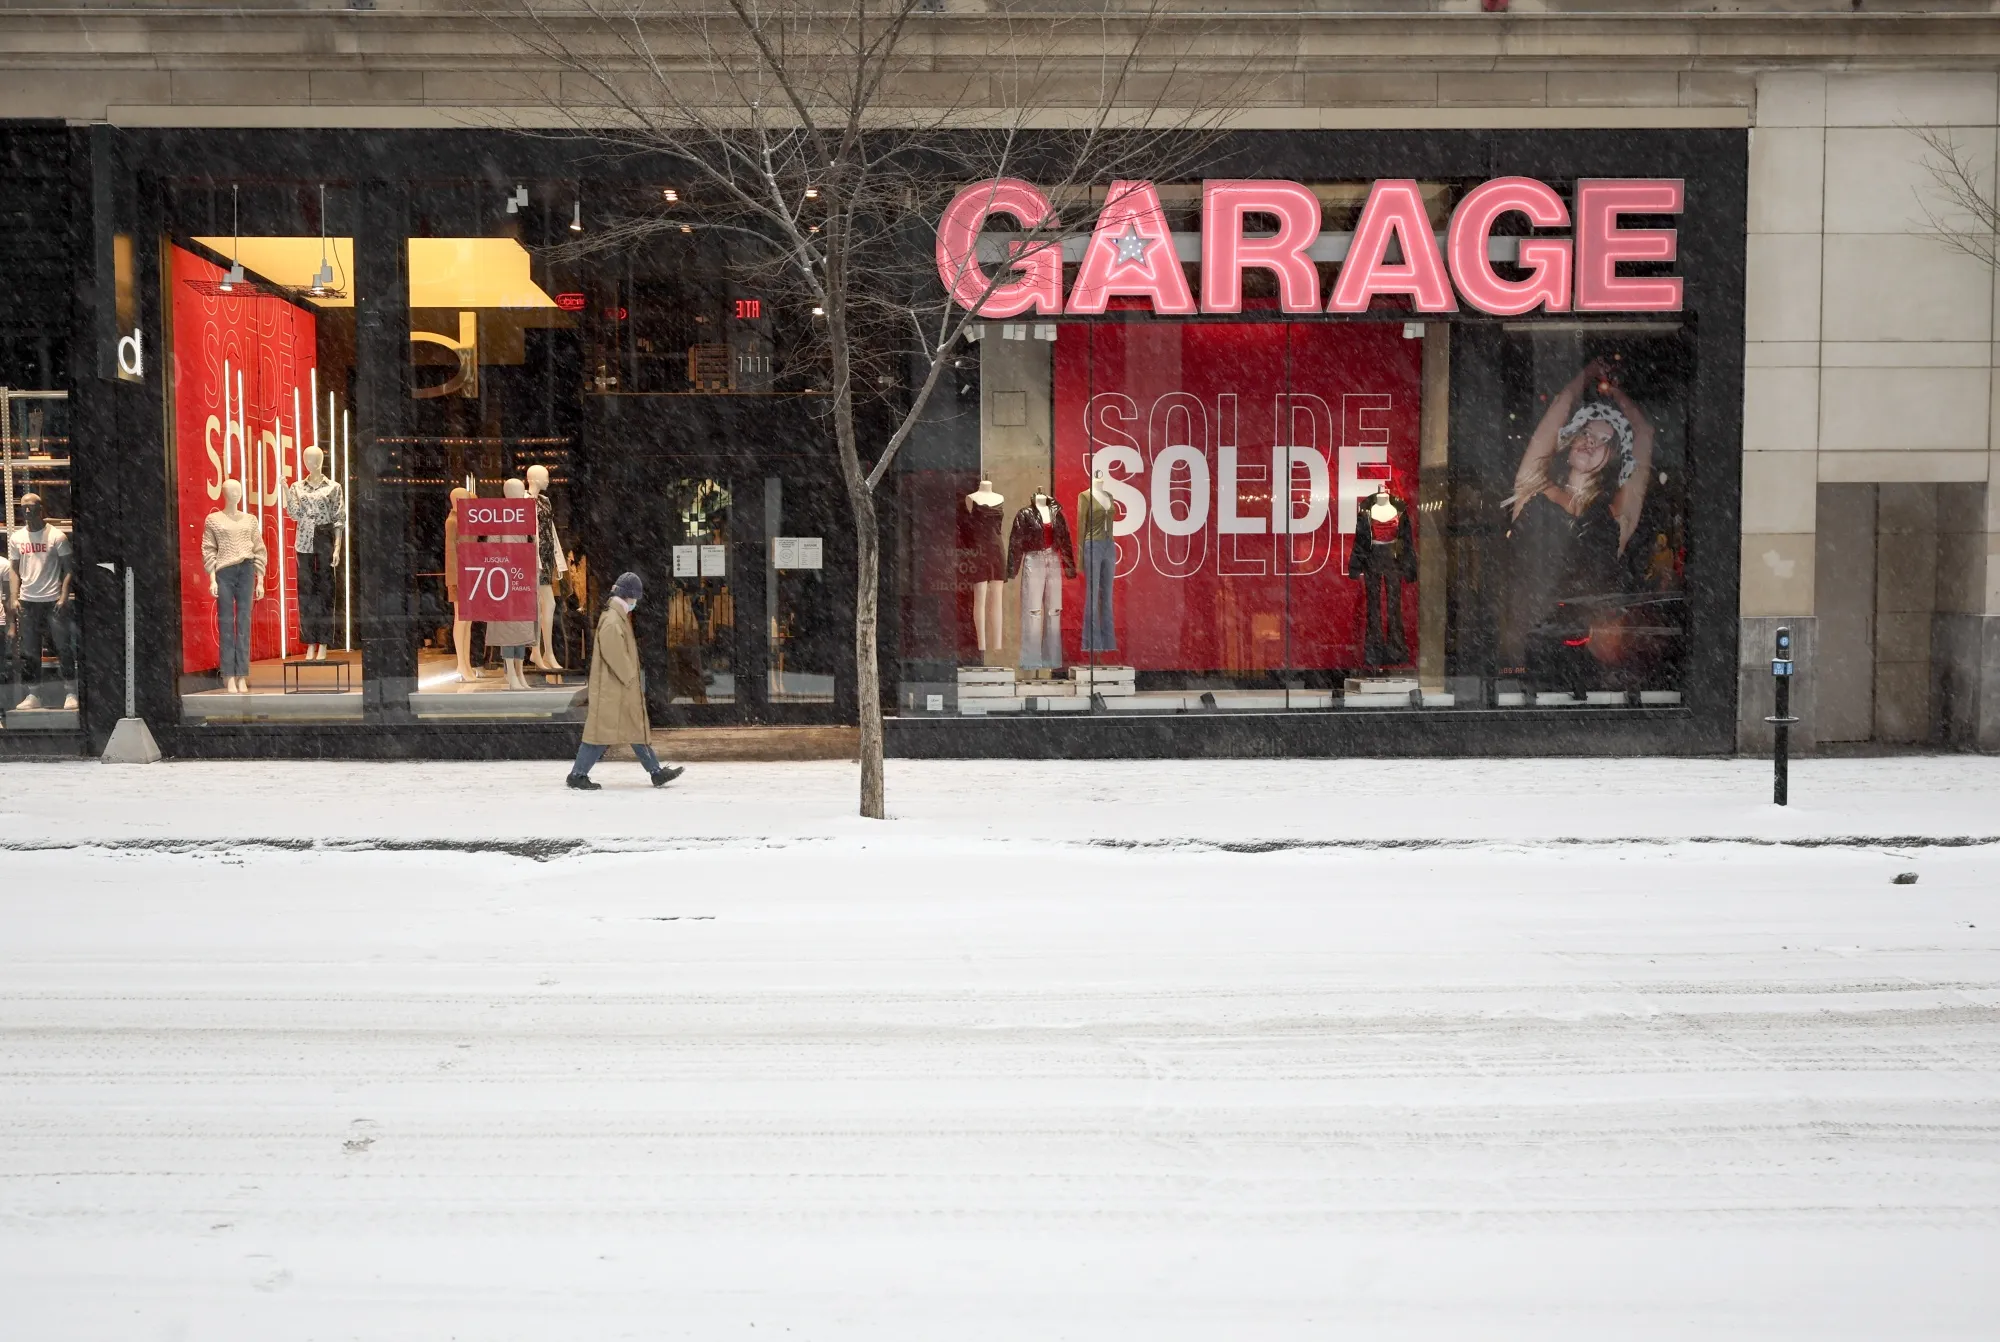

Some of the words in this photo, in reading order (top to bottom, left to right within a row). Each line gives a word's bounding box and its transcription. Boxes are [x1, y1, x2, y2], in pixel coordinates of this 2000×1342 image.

[936, 177, 1684, 316] GARAGE
[118, 328, 142, 377] d
[468, 508, 525, 523] SOLDE
[20, 542, 48, 555] SOLDE
[484, 555, 509, 563] JUSQU'À
